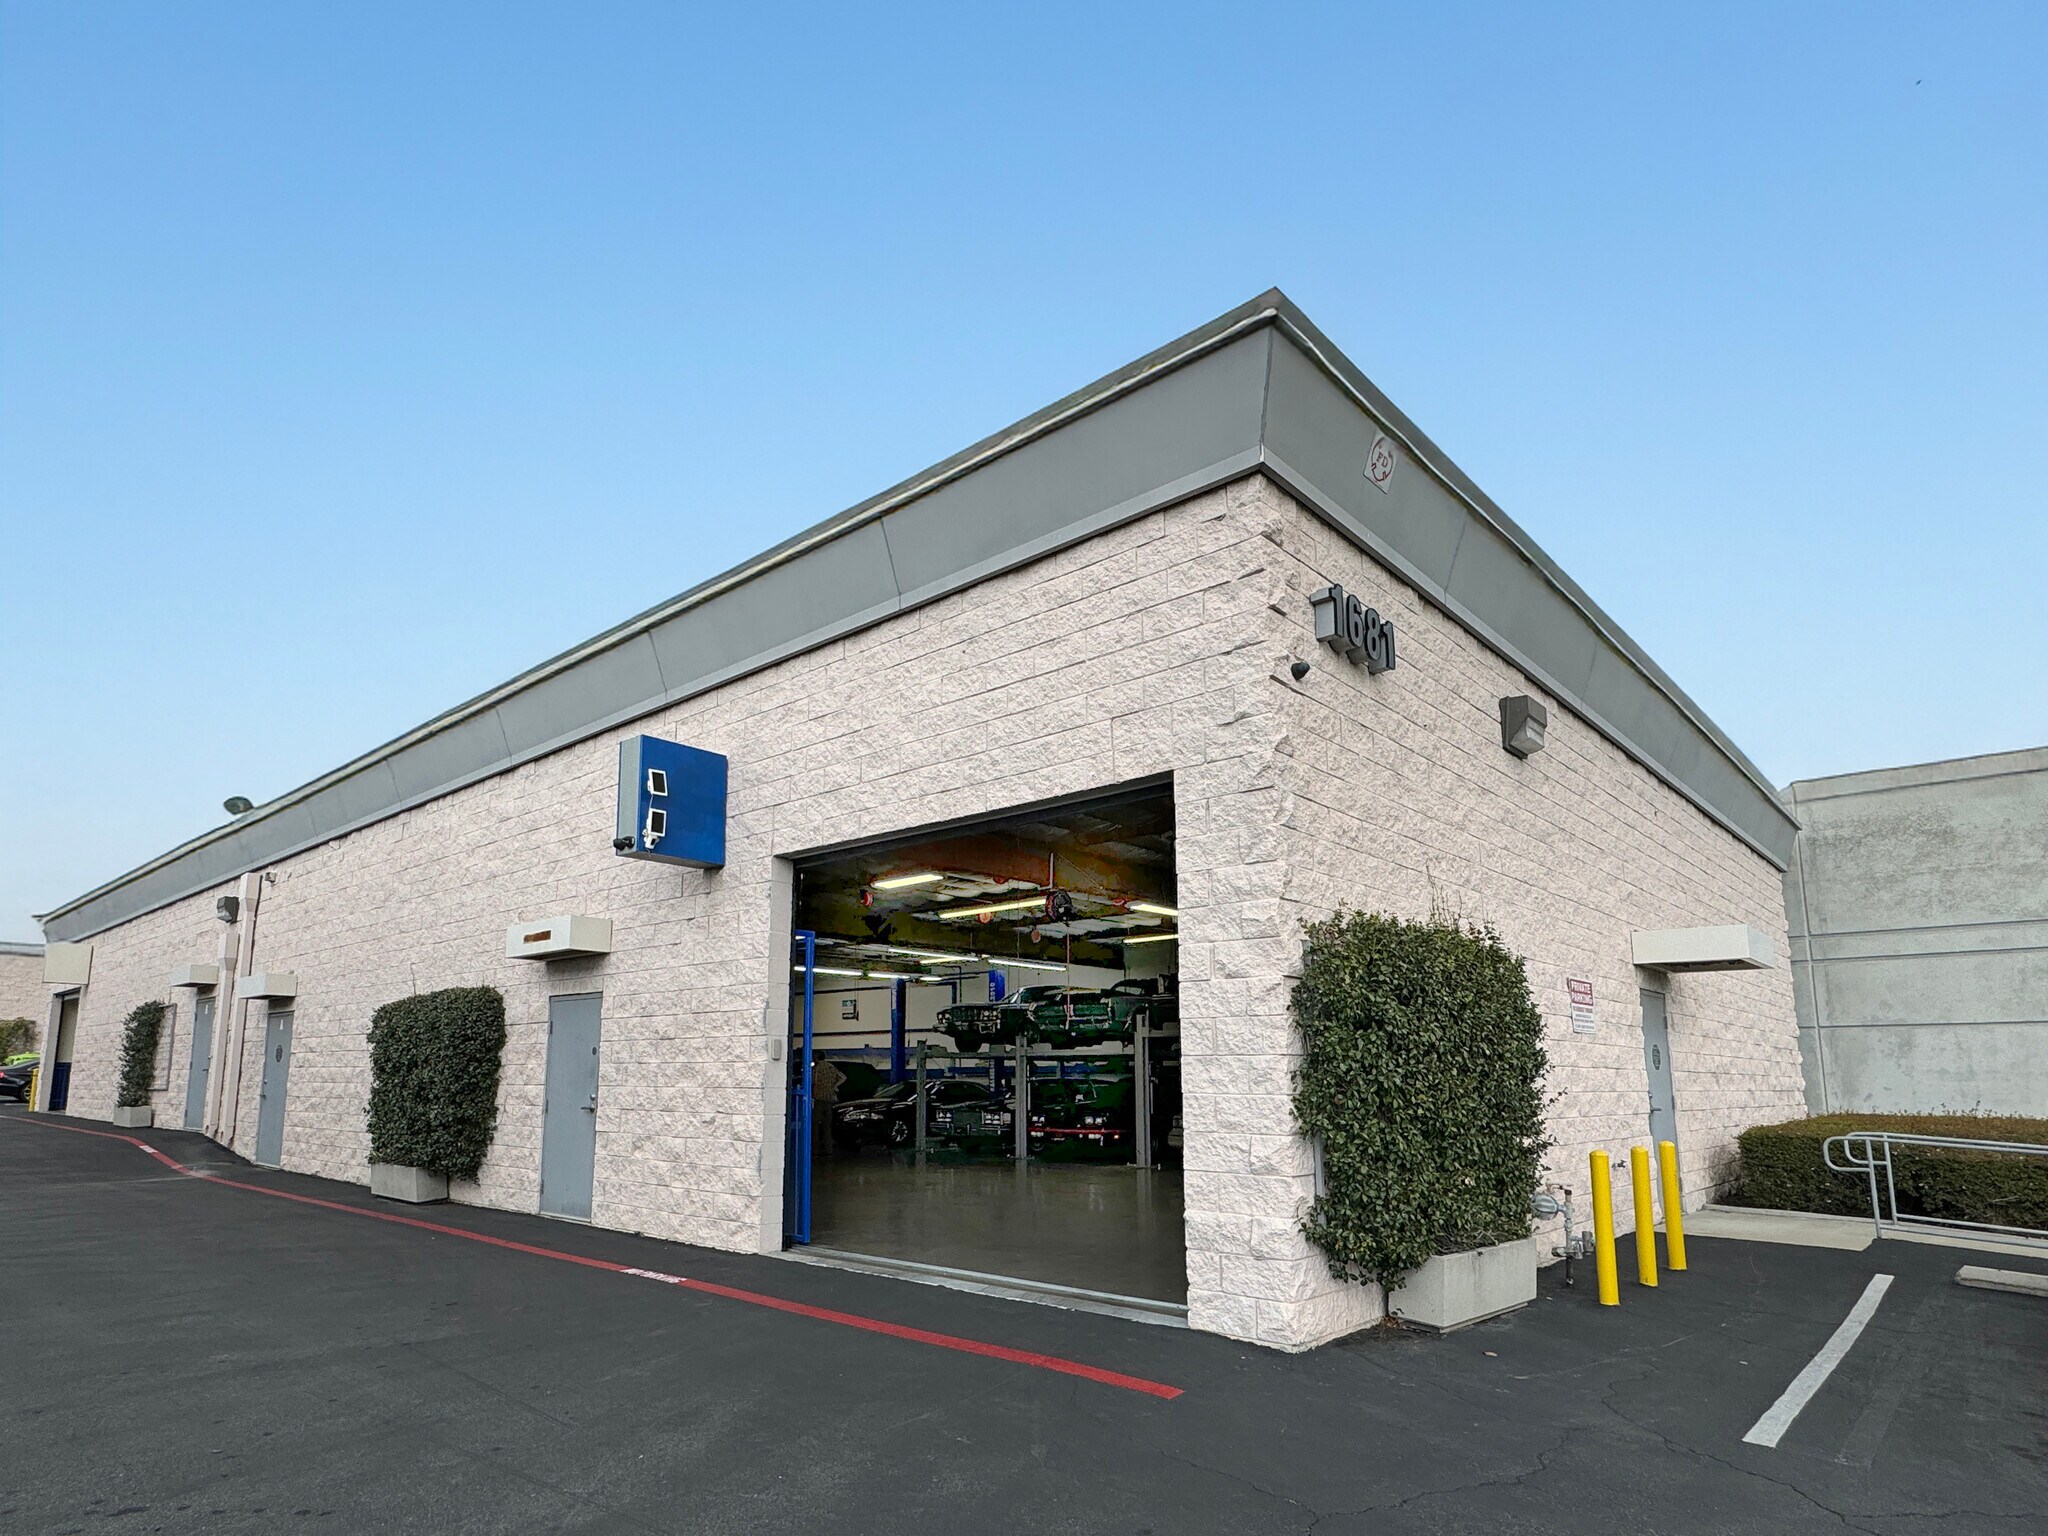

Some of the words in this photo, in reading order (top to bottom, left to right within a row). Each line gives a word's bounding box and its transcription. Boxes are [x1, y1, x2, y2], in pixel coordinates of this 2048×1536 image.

[1326, 583, 1396, 671] 1681
[1571, 980, 1592, 994] PRIVATE
[1571, 991, 1592, 1004] PARKING
